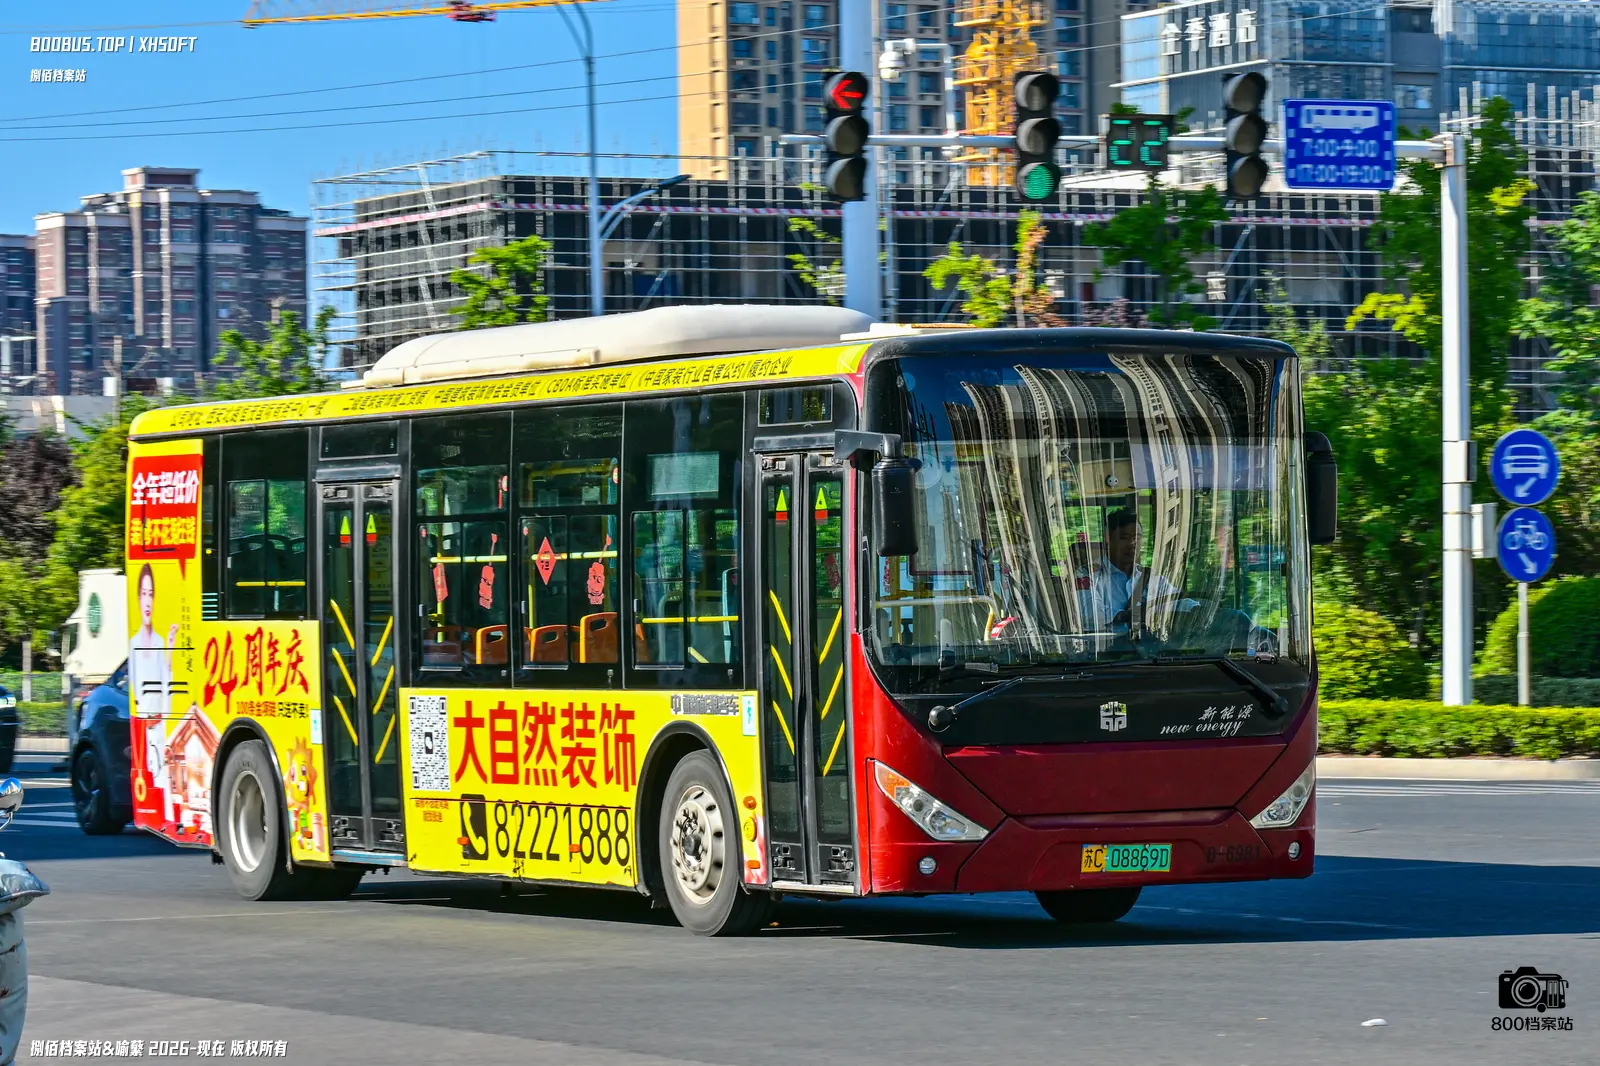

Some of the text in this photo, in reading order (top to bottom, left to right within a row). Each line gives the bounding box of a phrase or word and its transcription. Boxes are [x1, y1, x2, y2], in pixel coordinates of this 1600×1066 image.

[1109, 119, 1168, 166] 22
[130, 469, 200, 505] 全年超低价
[204, 626, 309, 715] 24周年庆
[1160, 721, 1244, 737] new energy
[1198, 703, 1254, 722] 新能源
[453, 700, 637, 792] 大自然装饰
[495, 799, 630, 867] 82221888
